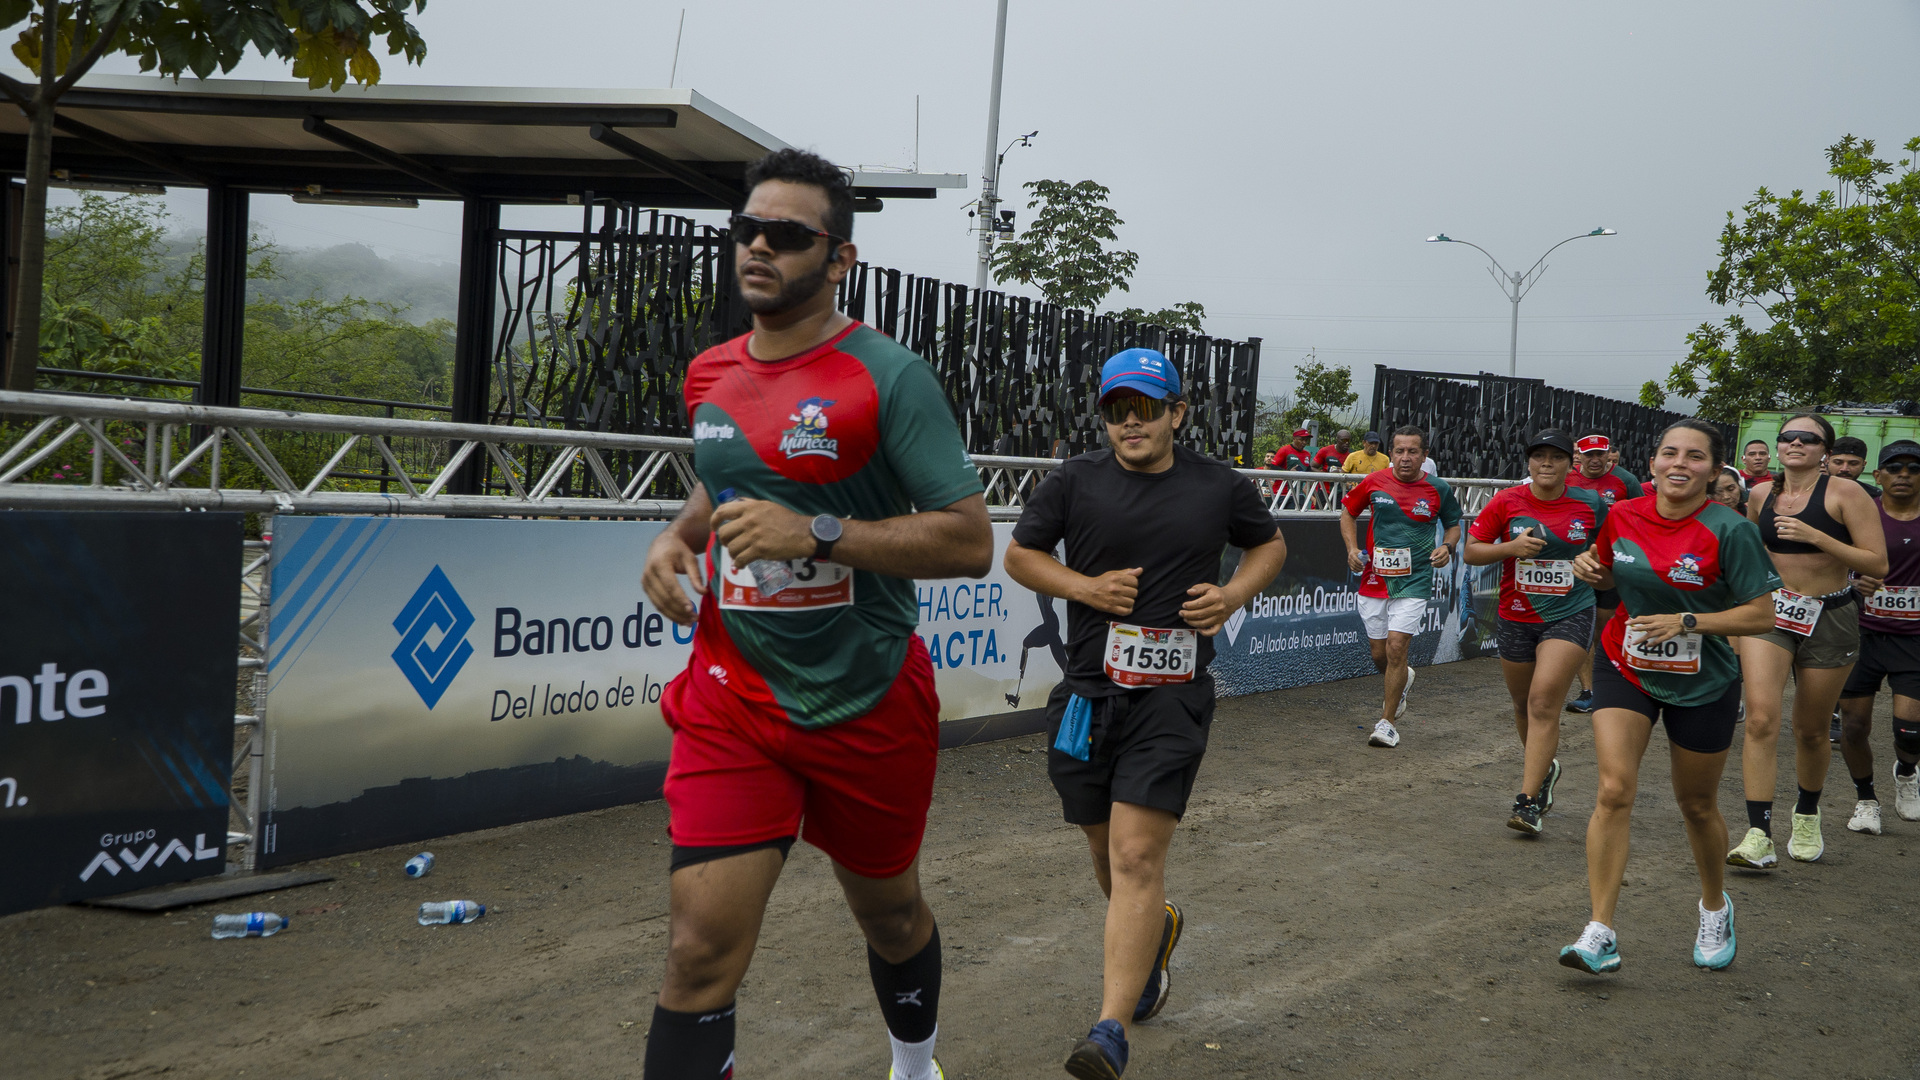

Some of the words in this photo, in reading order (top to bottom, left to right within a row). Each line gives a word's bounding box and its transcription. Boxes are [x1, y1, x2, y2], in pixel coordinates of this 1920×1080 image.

[1379, 556, 1400, 567] 134
[1525, 570, 1563, 584] 1095
[918, 583, 1008, 622] HACER,
[1252, 592, 1293, 618] Banco
[1295, 587, 1311, 615] de
[1313, 585, 1359, 613] Occiden
[1875, 596, 1915, 609] 1861
[494, 607, 614, 658] Banco
[622, 602, 664, 648] de
[1249, 635, 1266, 654] Del
[1266, 632, 1287, 652] lado
[1288, 631, 1299, 650] de
[1301, 630, 1313, 648] los
[1315, 634, 1331, 651] que
[1332, 627, 1359, 646] hacen.
[918, 629, 1006, 669] ACTA.
[1480, 638, 1498, 650] AVAL
[1637, 641, 1678, 657] 440
[1123, 645, 1182, 670] 1536
[490, 685, 536, 722] Del
[543, 680, 599, 716] lado
[605, 676, 635, 708] de
[101, 829, 156, 847] Grupo
[79, 833, 219, 883] AVAL
